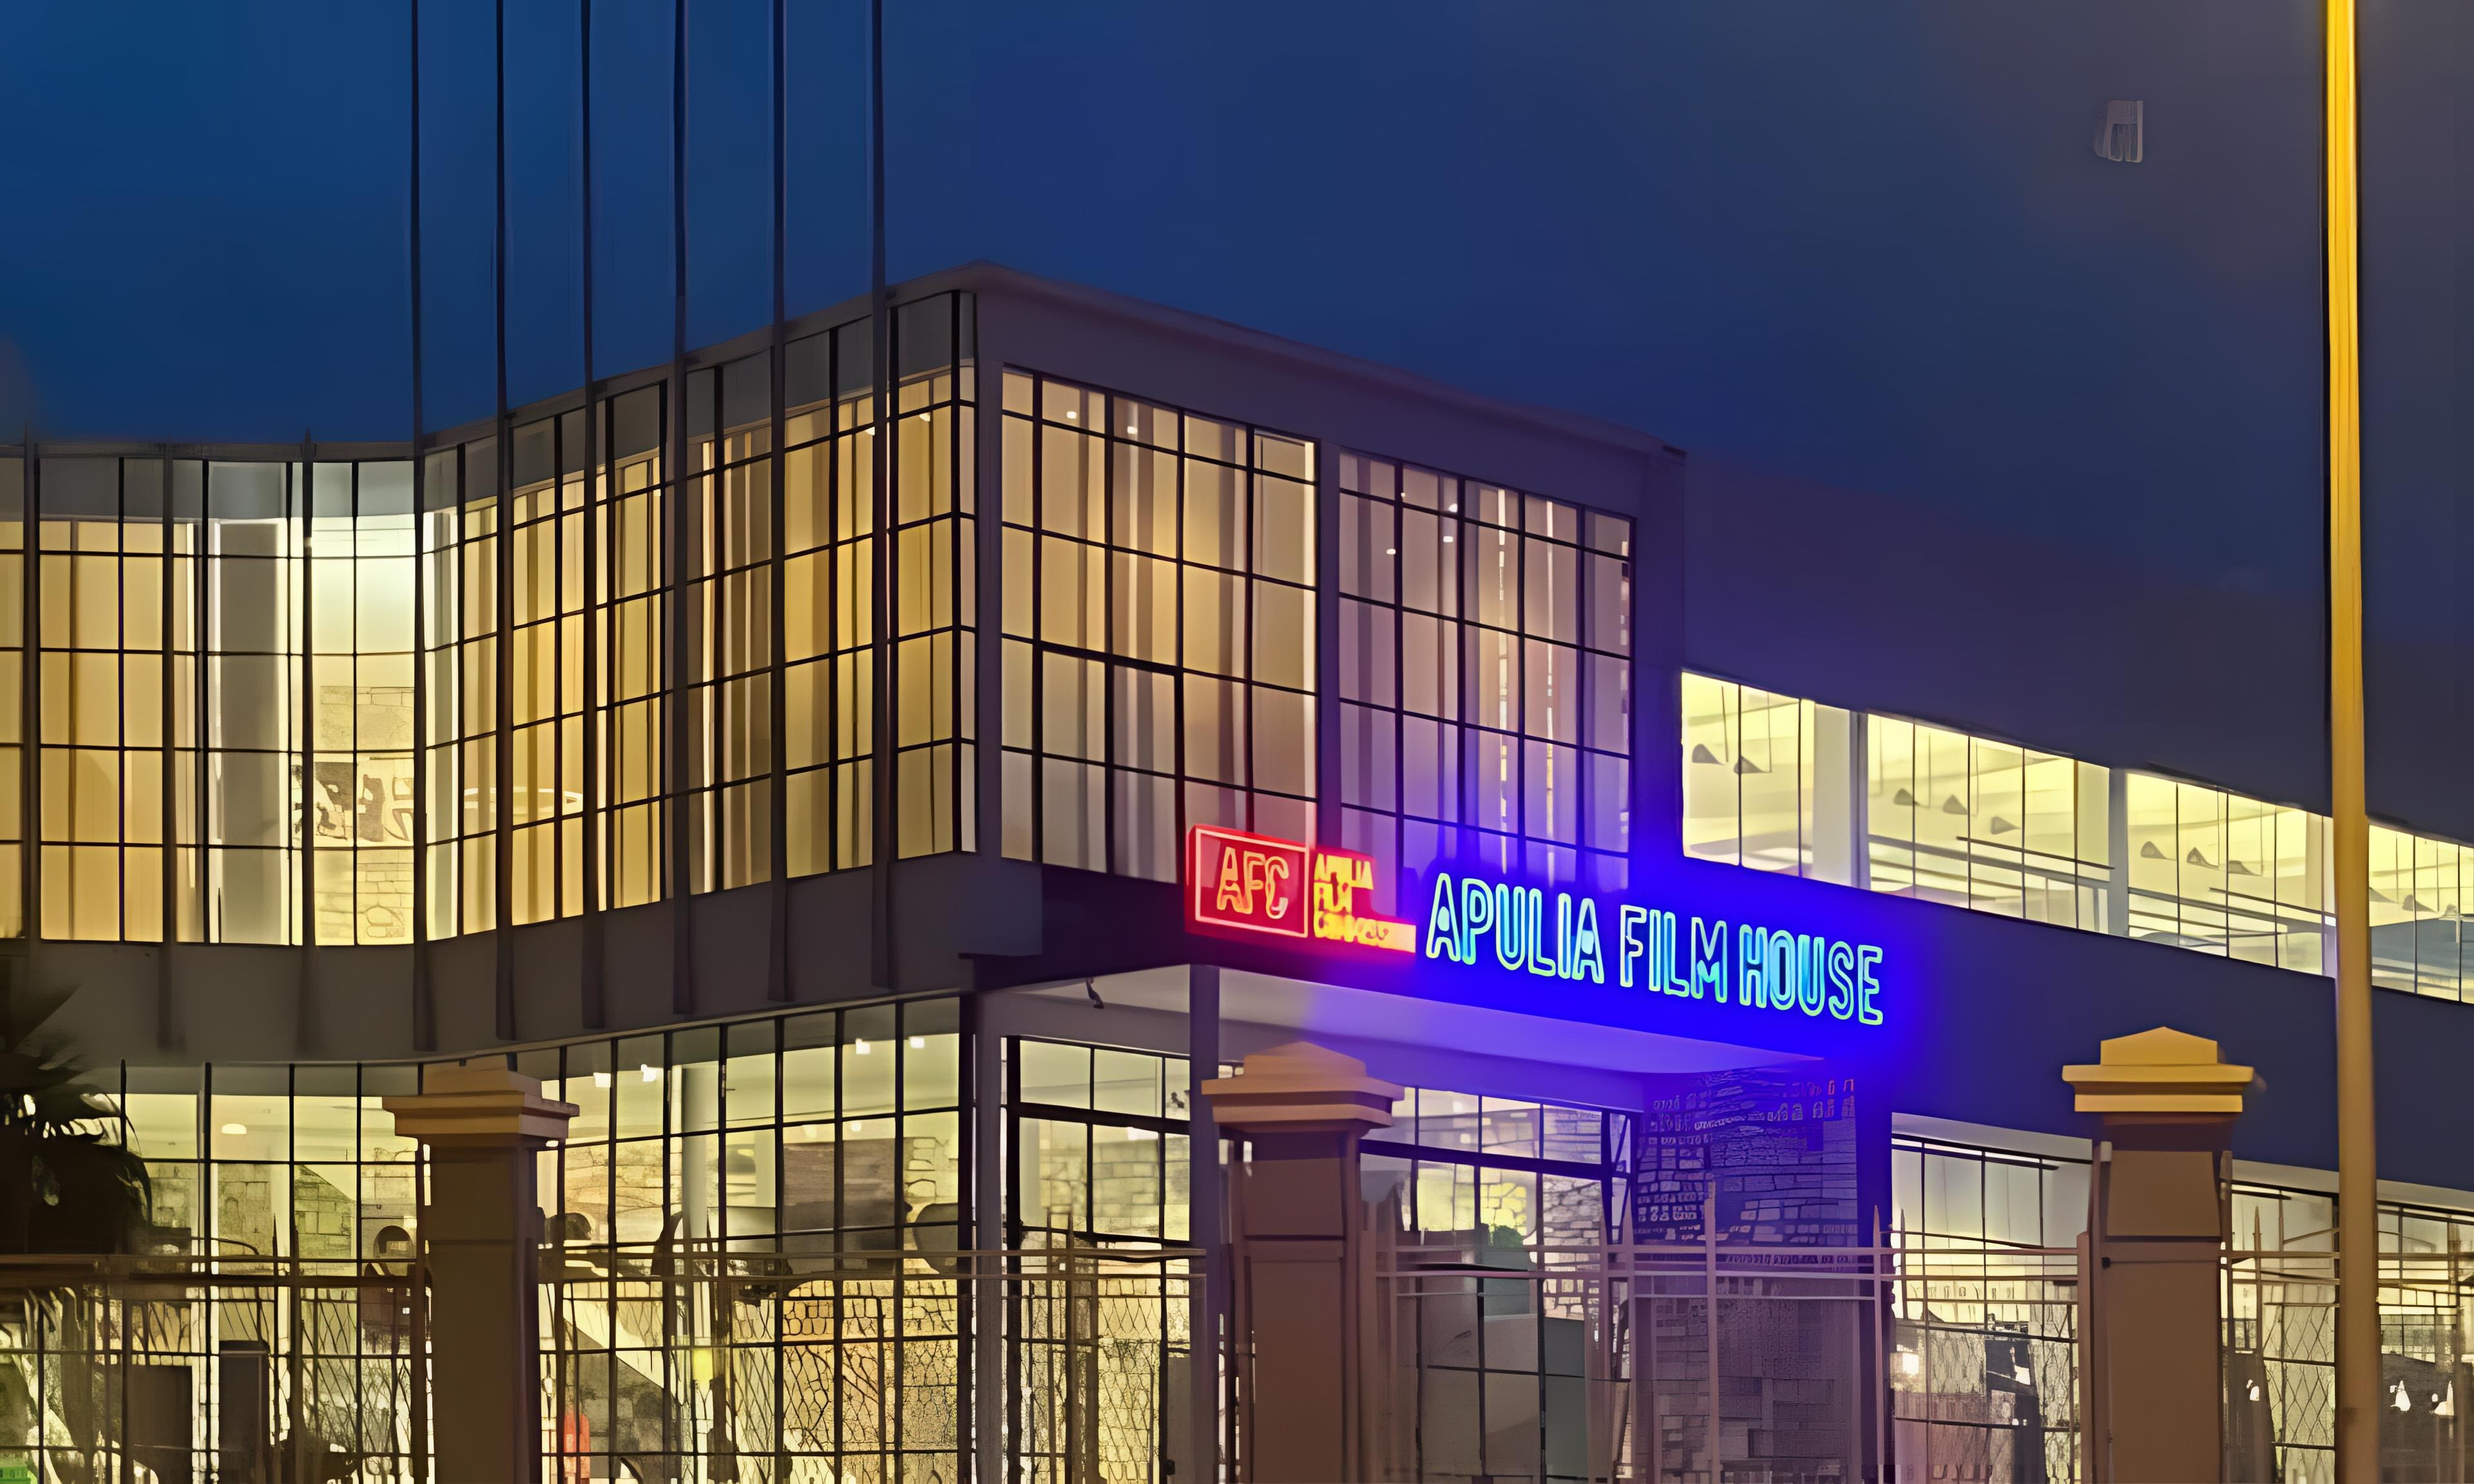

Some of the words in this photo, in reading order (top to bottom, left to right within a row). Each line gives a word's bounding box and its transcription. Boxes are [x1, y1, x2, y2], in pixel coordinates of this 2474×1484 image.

[1216, 846, 1289, 919] AFC
[1425, 873, 1604, 984] APULIA
[1620, 904, 1727, 1004] FILM
[1740, 924, 1884, 1025] HOUSE
